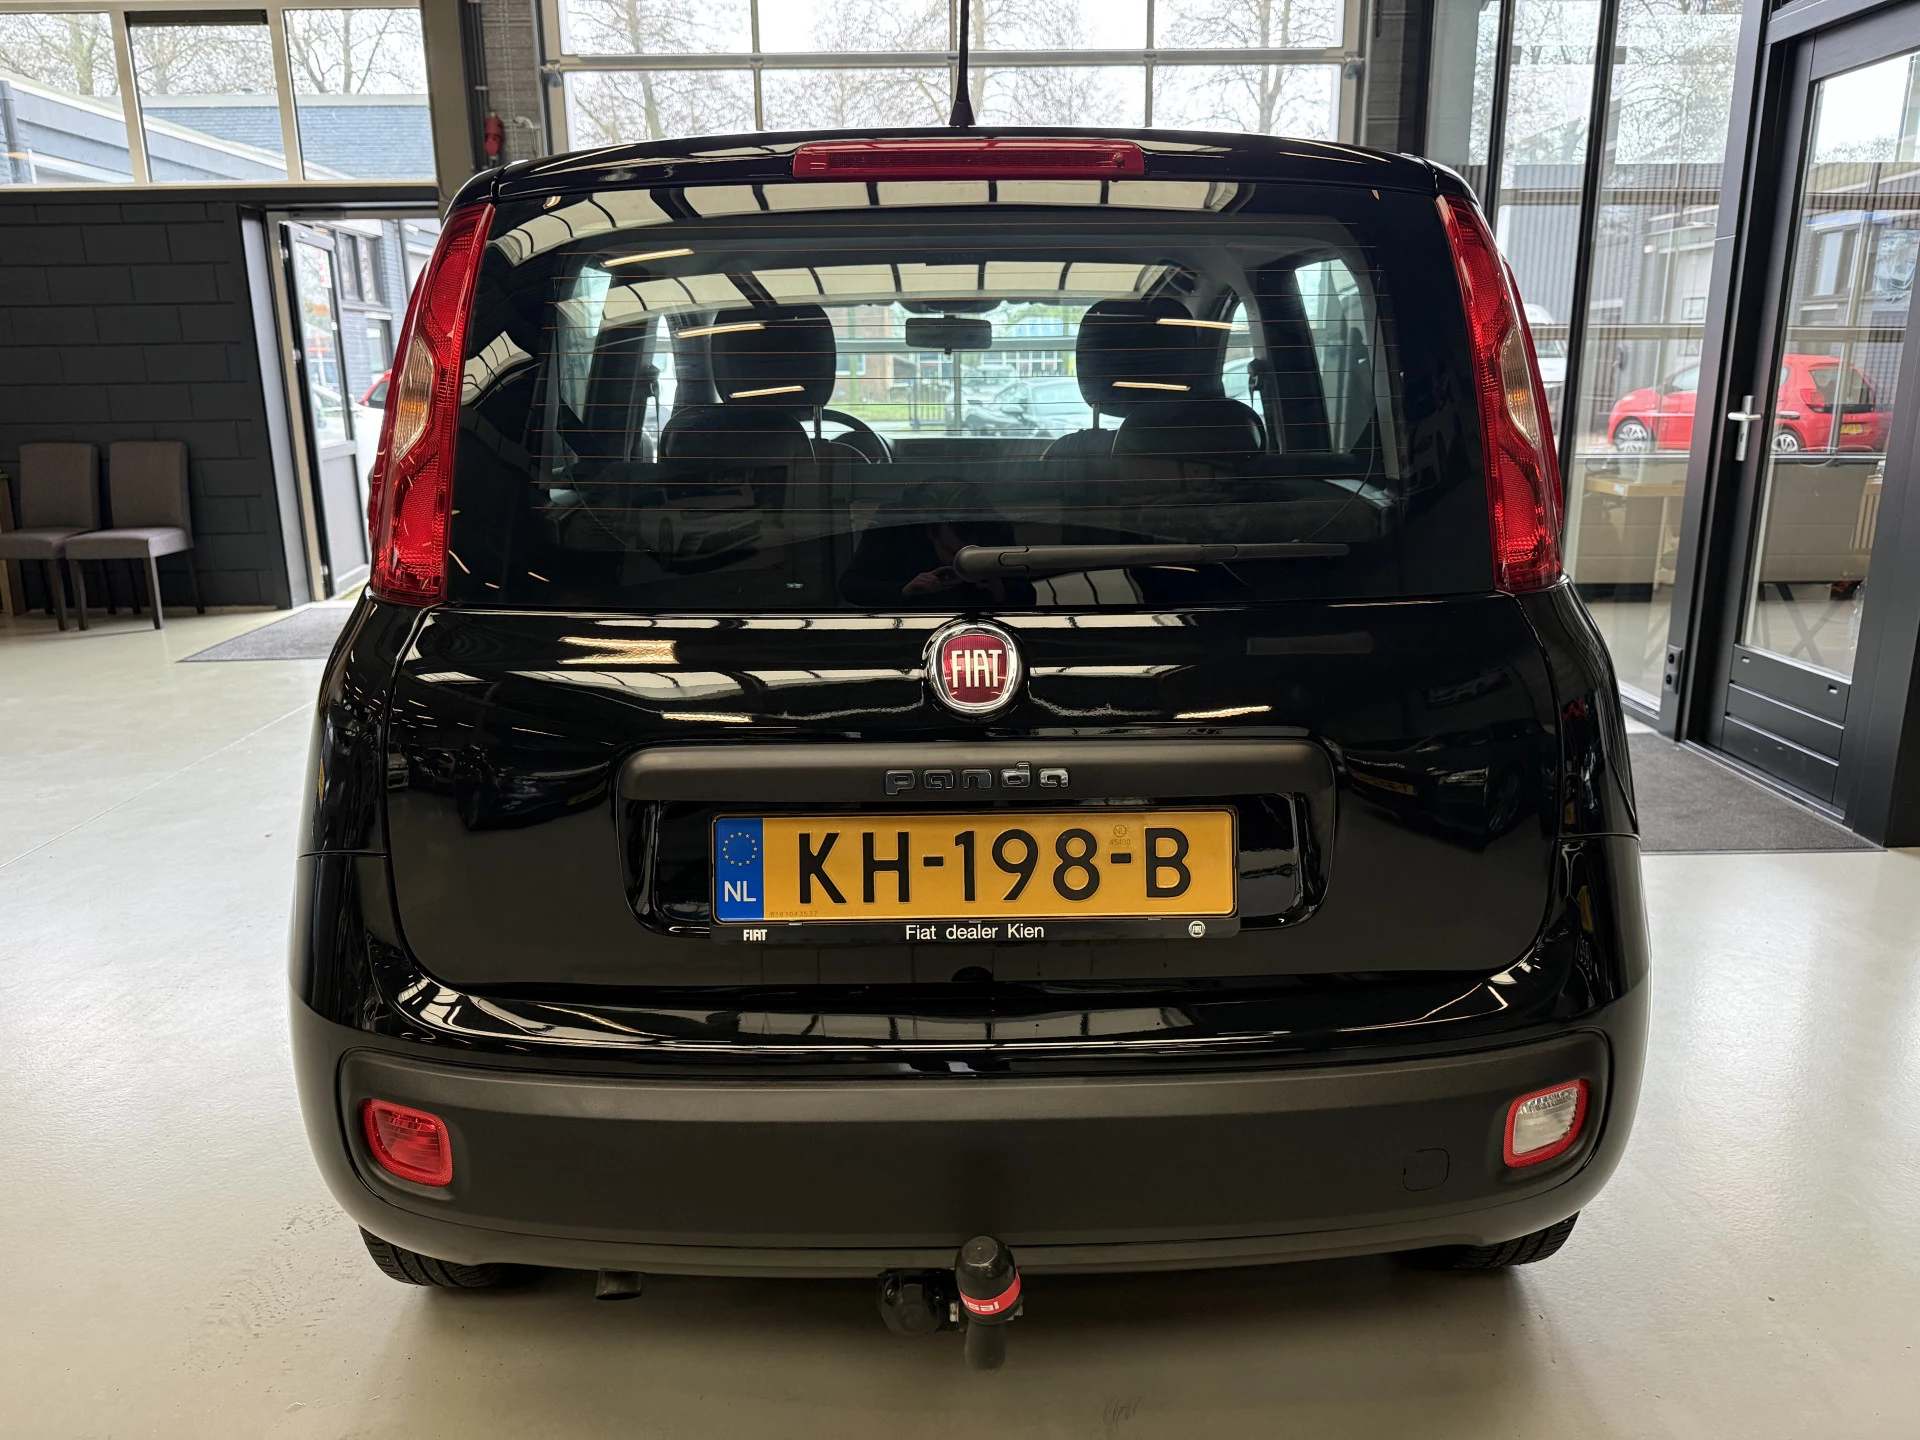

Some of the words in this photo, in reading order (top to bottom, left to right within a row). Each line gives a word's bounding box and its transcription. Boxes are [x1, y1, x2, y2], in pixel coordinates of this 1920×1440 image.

[951, 650, 1003, 688] FIAT
[885, 761, 1070, 795] panda
[799, 828, 1192, 904] KH-198-B
[724, 880, 757, 902] NL
[743, 929, 768, 941] FIAT
[905, 925, 937, 940] Fiat
[945, 923, 999, 939] dealer
[1007, 923, 1045, 939] Kien
